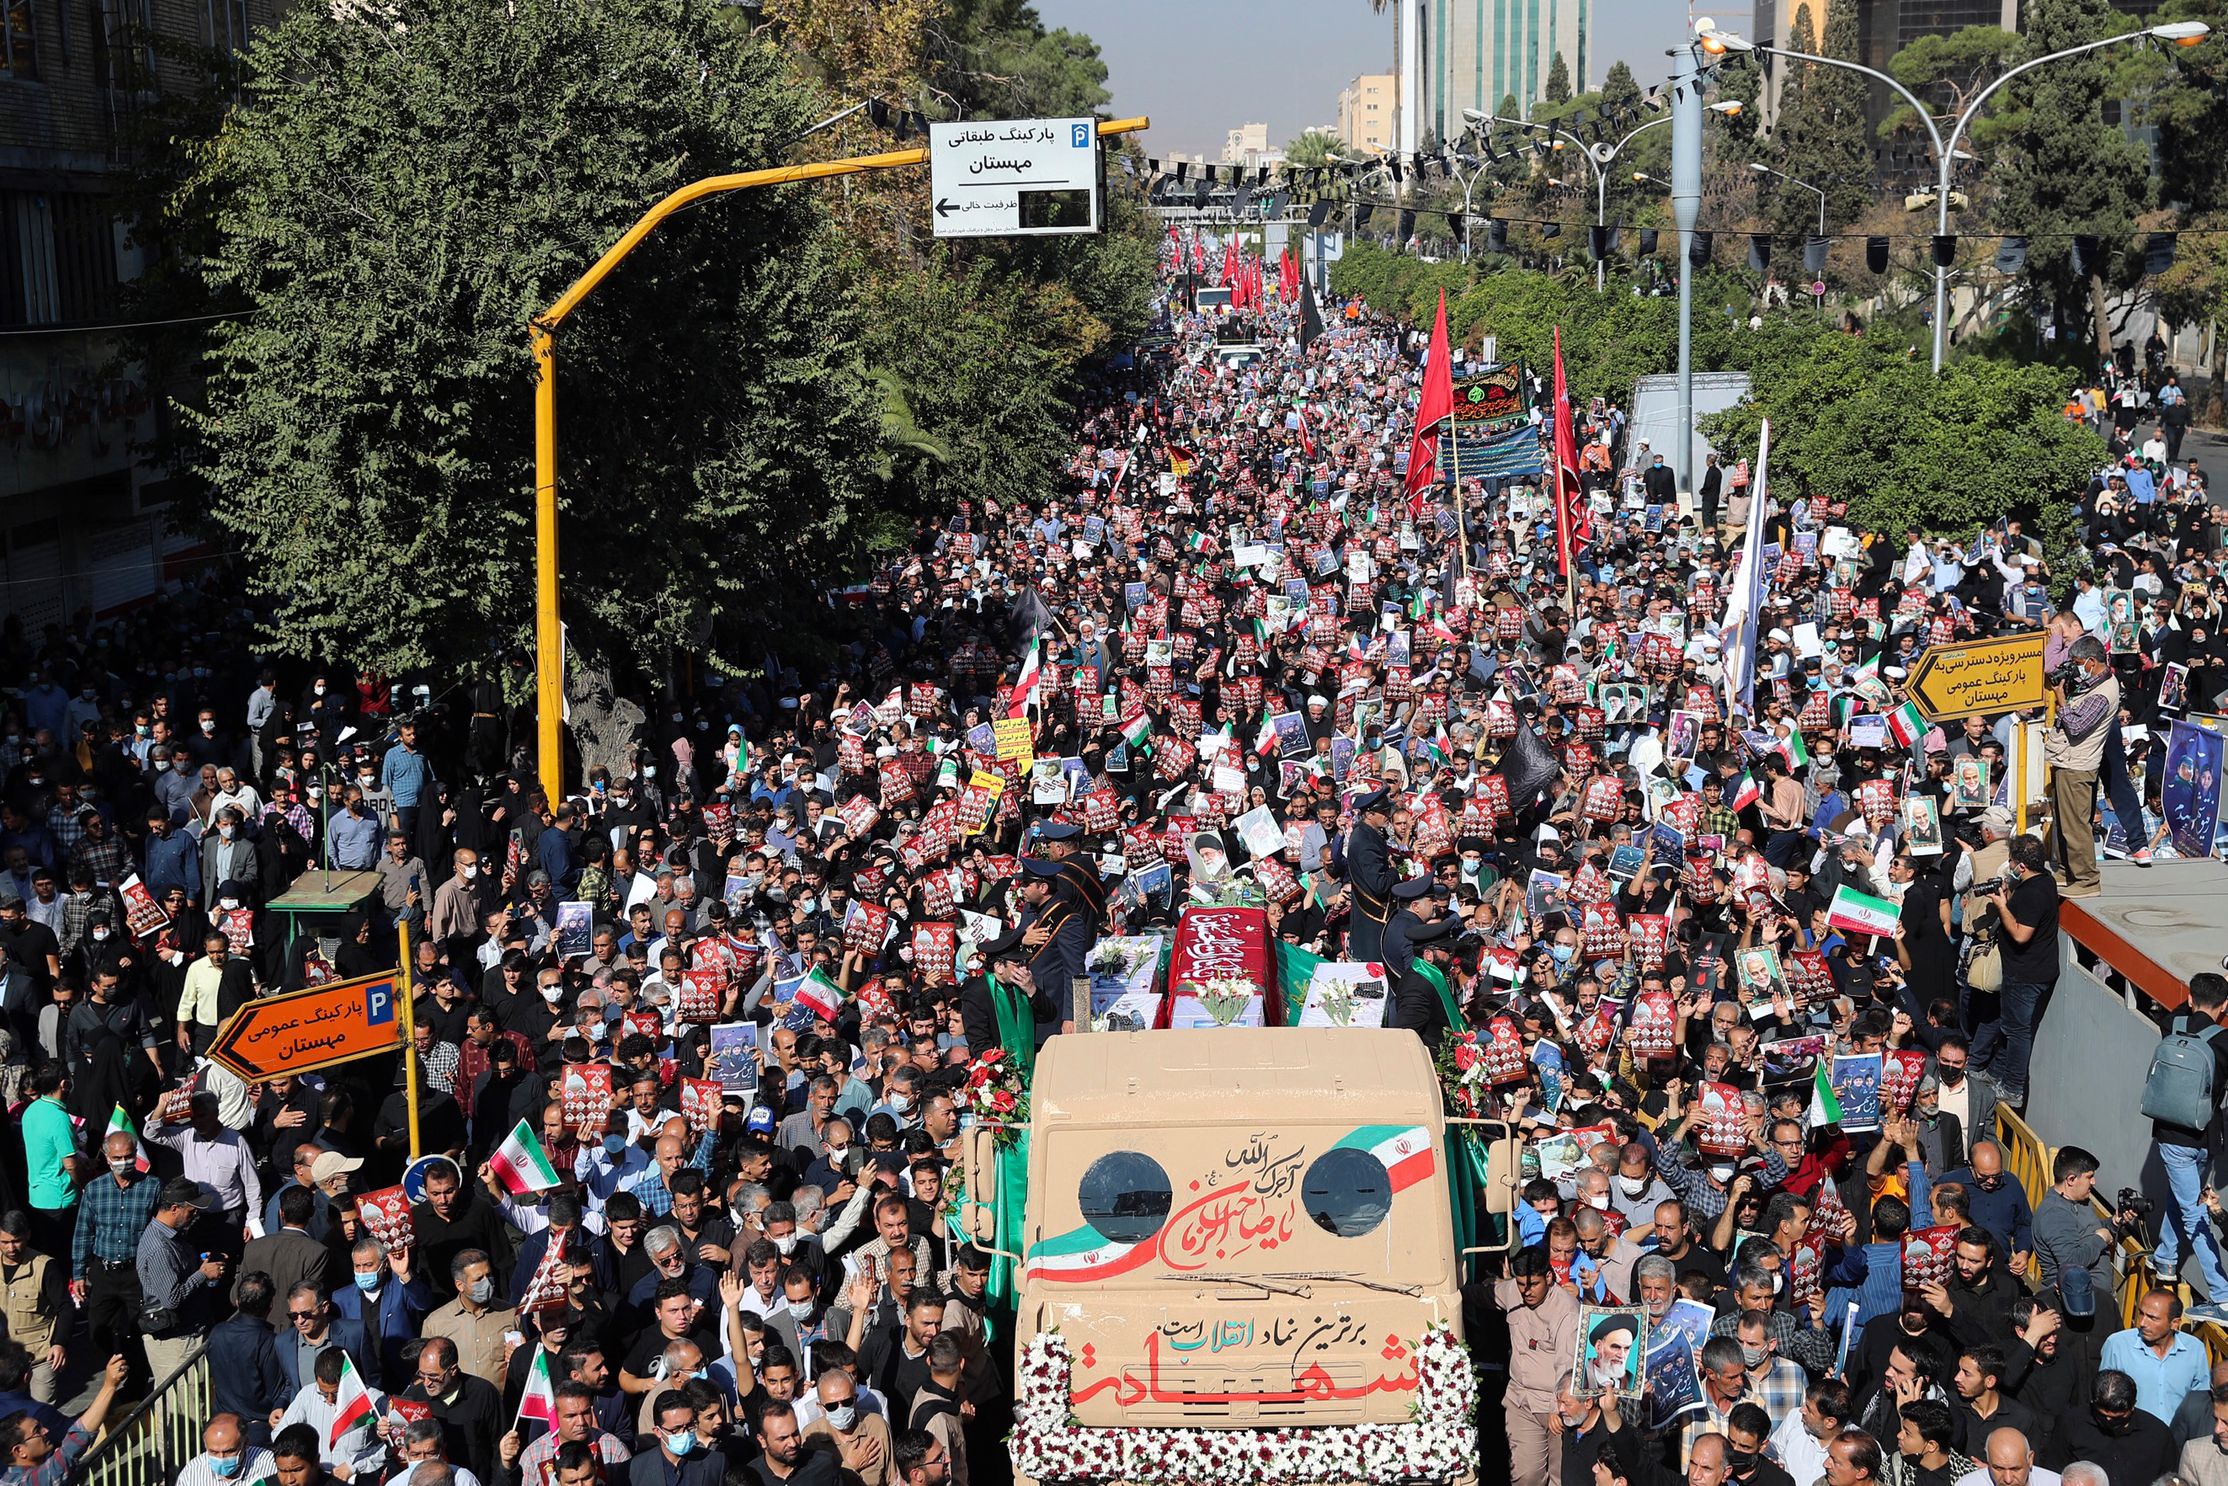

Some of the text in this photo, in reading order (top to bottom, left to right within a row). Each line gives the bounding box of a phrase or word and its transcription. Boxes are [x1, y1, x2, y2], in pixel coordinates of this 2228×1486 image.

[948, 127, 1055, 147] پارکینگ طبقاتی
[1075, 131, 1085, 146] P
[969, 156, 1032, 173] مهستان
[961, 199, 1018, 212] ظرفیت خالی
[1945, 656, 1993, 674] دسترسی
[1994, 653, 2016, 667] ویژه
[2015, 650, 2042, 663] مسیر
[1933, 661, 1946, 674] به
[1946, 668, 2026, 695] پارکینگ عمومی
[1964, 689, 2008, 706] مهستان
[371, 992, 386, 1017] P
[247, 1000, 363, 1043] پارکینگ عمومی
[278, 1032, 346, 1061] مهستان
[1168, 1316, 1256, 1366] انقلاب
[1259, 1316, 1299, 1347] نماد
[1293, 1315, 1366, 1380] برترین
[1070, 1331, 1420, 1407] شهادت
